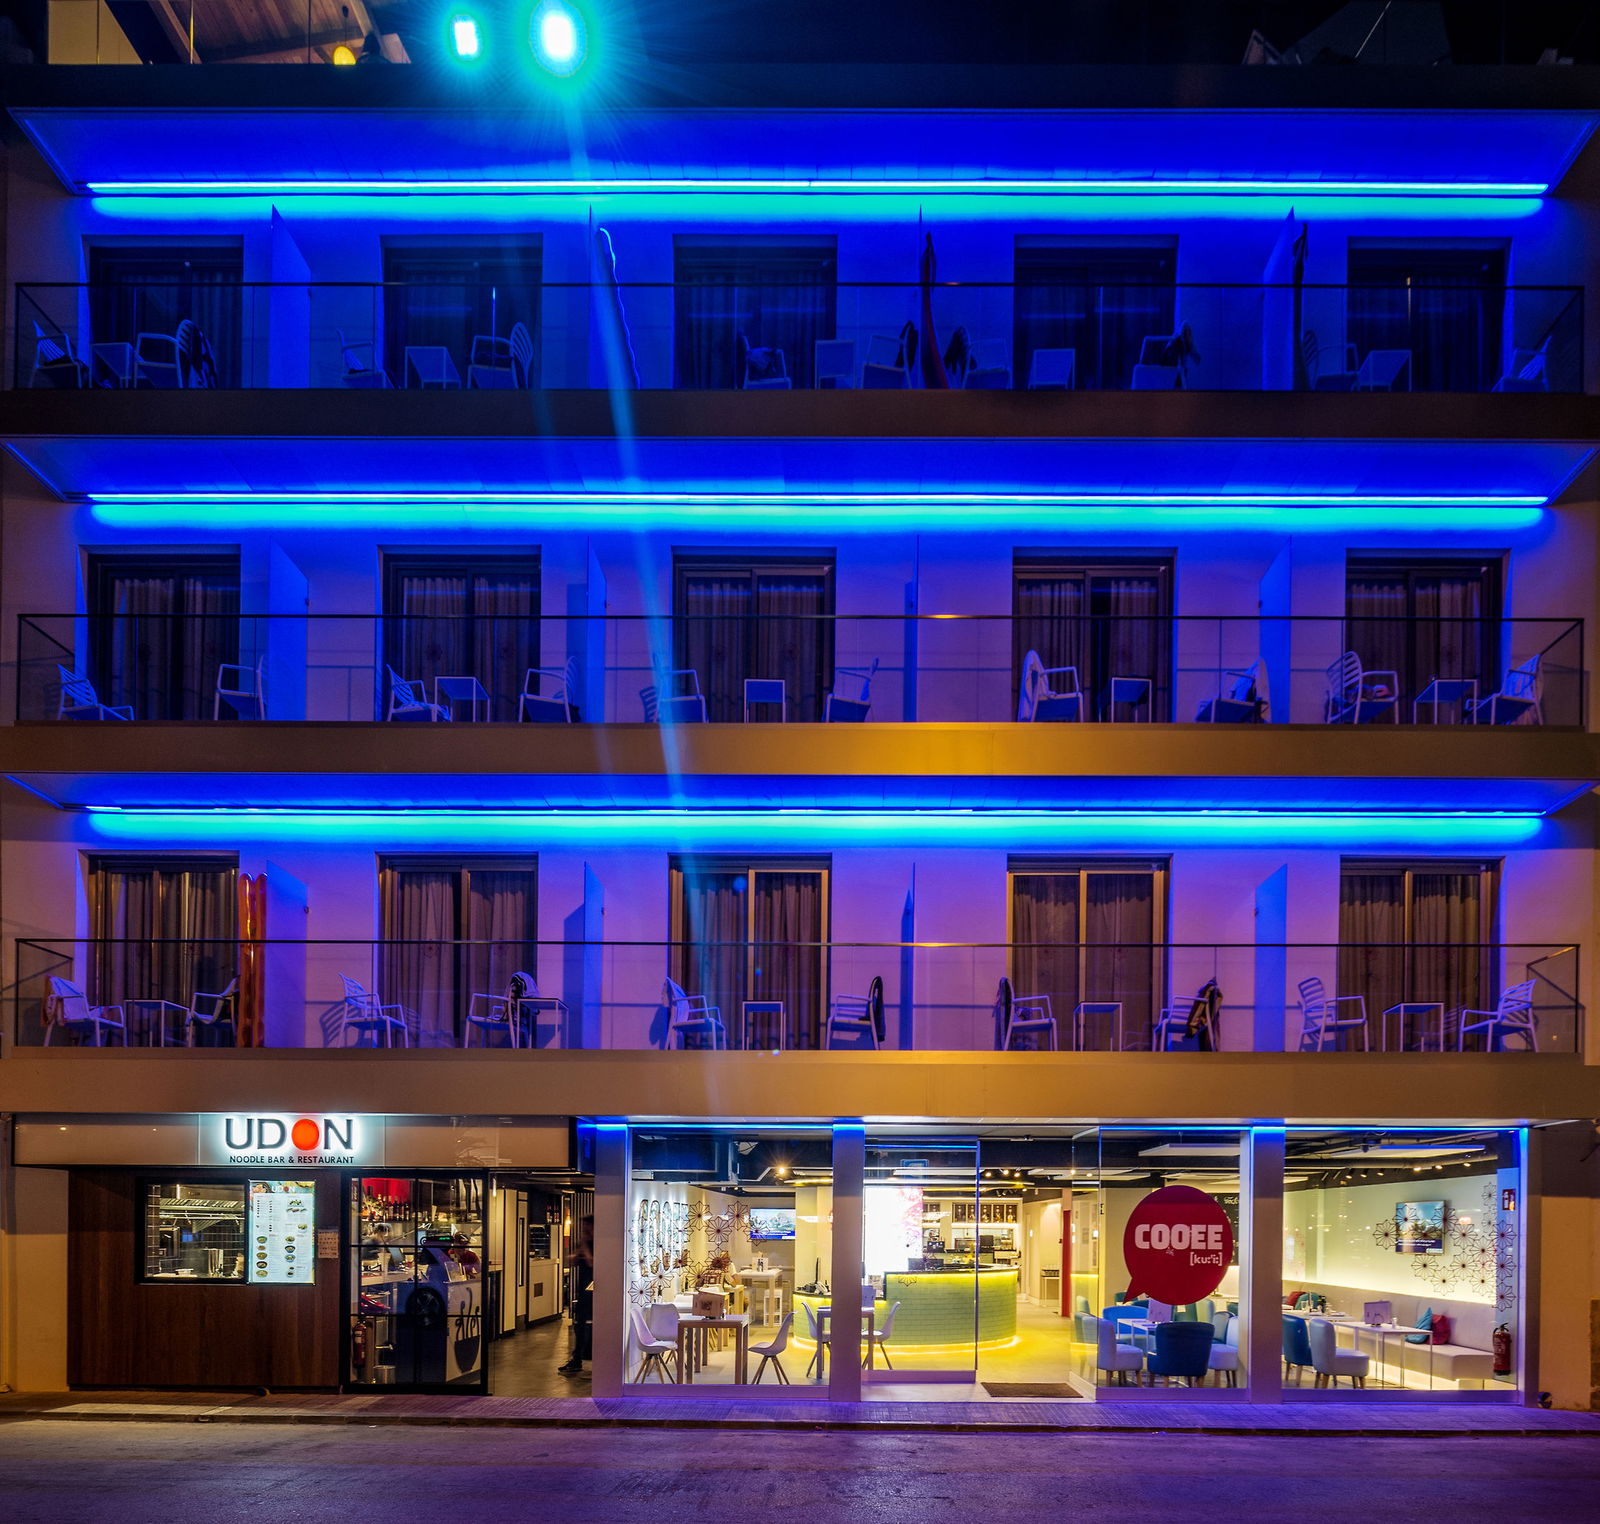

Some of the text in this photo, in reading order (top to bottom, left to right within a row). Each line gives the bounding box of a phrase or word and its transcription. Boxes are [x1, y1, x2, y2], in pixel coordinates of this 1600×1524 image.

[225, 1118, 354, 1151] UDON
[229, 1155, 355, 1165] NOODLE BAR & RESTAURANT
[1134, 1223, 1224, 1250] COOEE
